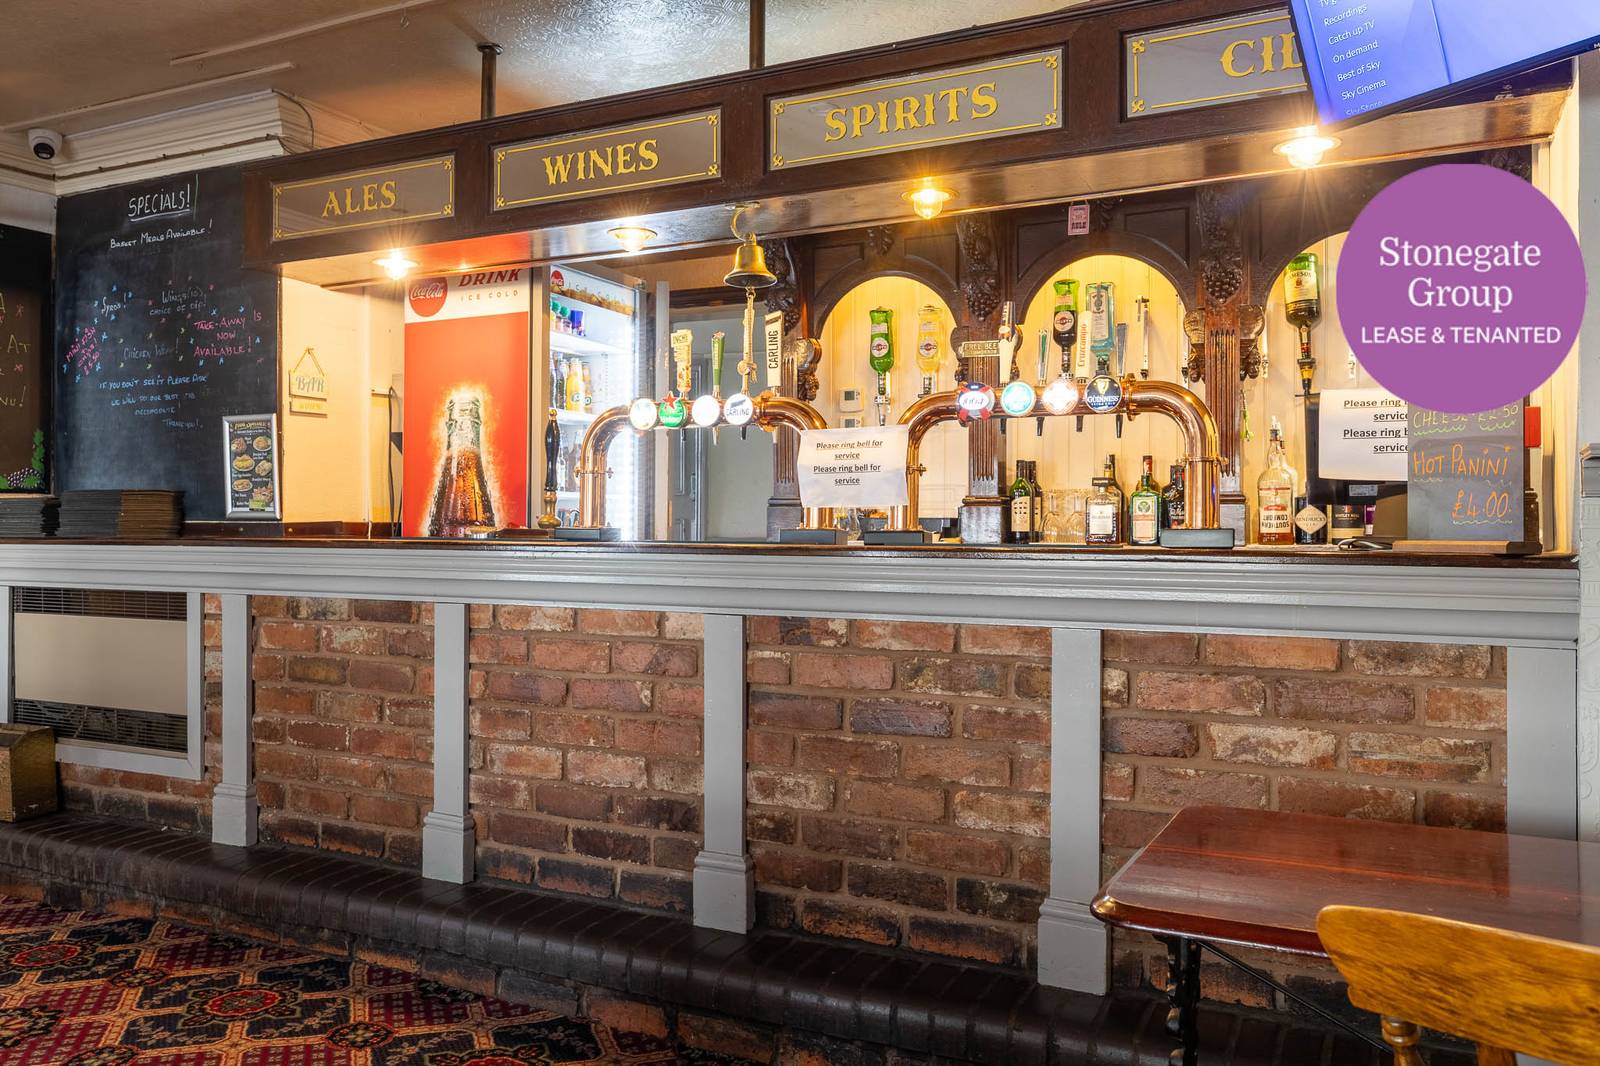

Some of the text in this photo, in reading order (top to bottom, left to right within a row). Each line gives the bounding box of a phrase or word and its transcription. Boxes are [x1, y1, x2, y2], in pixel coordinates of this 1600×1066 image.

[1324, 4, 1367, 26] Recordings
[1329, 19, 1375, 45] Catch up TV
[1333, 40, 1378, 63] On demand
[1337, 61, 1381, 82] Best of Sky
[1342, 79, 1386, 101] Sky Cinema
[824, 82, 999, 142] SPIRITS
[542, 139, 659, 185] WINES
[321, 180, 397, 218] ALES
[458, 268, 523, 287] DRINK
[461, 290, 518, 302] ICE COLD
[216, 330, 236, 341] NOW
[768, 330, 779, 370] CARLING
[1078, 324, 1087, 368] Cruzcampo
[1087, 395, 1119, 403] GUINNESS
[1343, 399, 1378, 407] Please
[1380, 399, 1401, 408] ring
[1343, 429, 1377, 438] Please
[1380, 428, 1401, 438] ring
[841, 441, 855, 449] ring
[856, 440, 870, 448] bell
[872, 439, 883, 447] for
[835, 451, 860, 459] service
[813, 463, 881, 473] Please ring bell for
[835, 476, 860, 484] service
